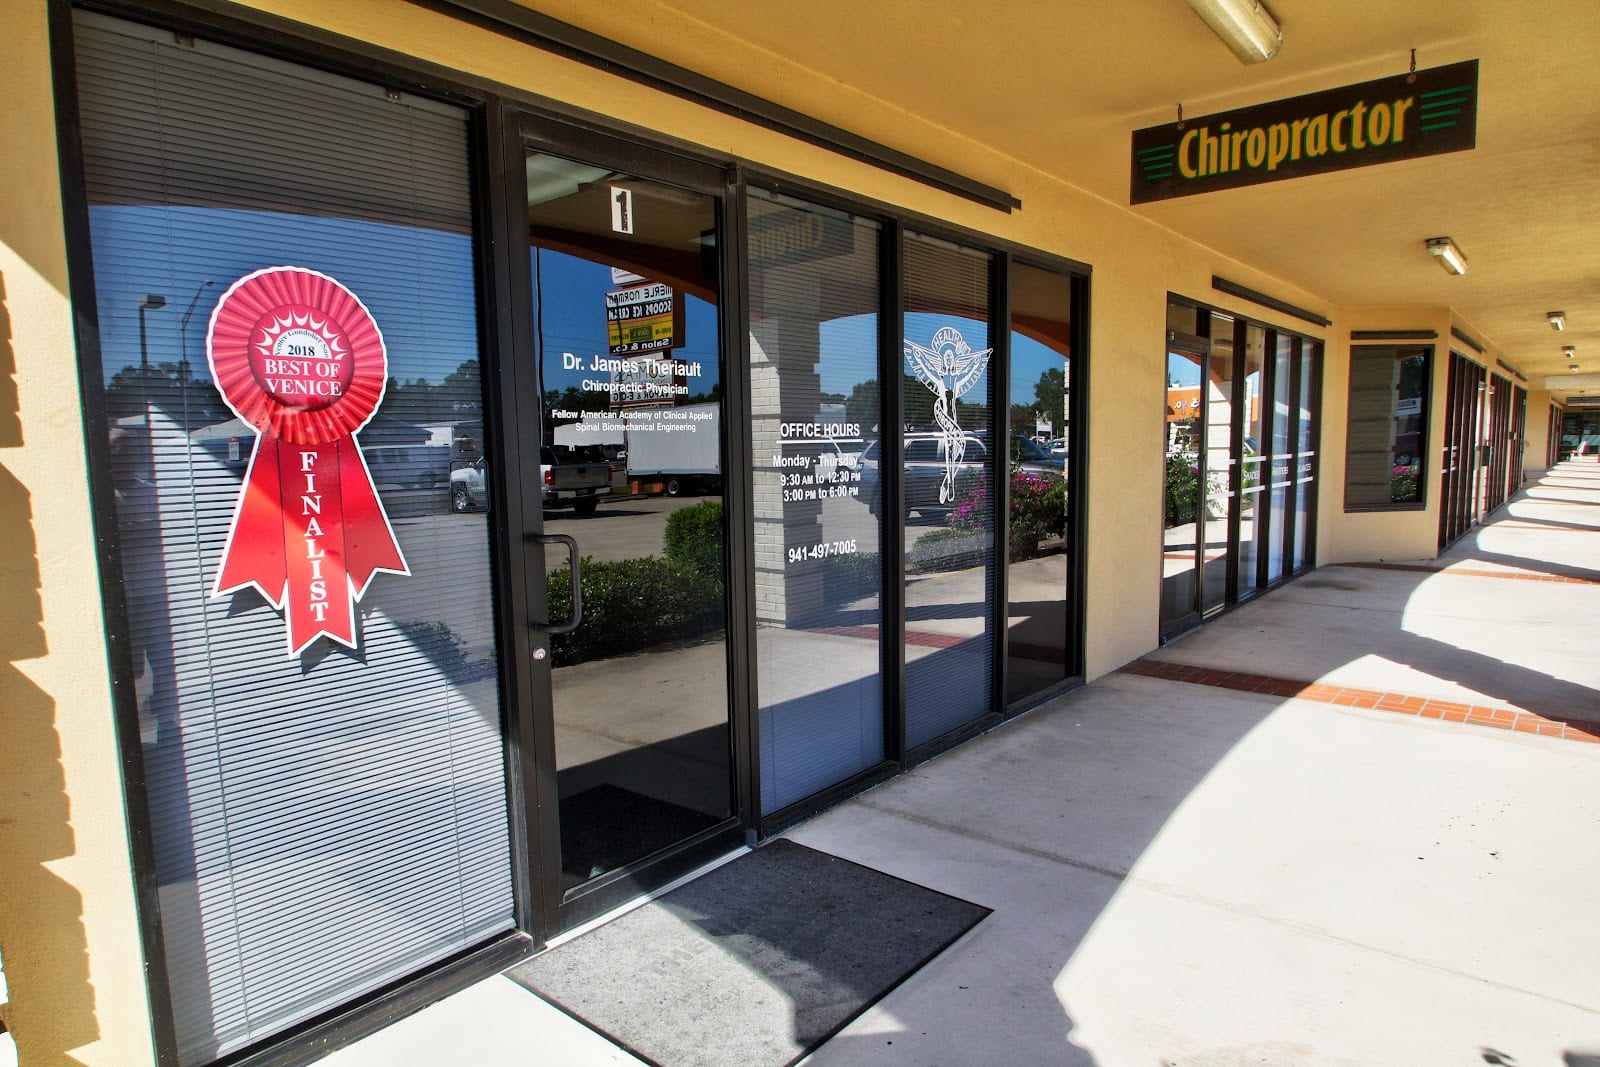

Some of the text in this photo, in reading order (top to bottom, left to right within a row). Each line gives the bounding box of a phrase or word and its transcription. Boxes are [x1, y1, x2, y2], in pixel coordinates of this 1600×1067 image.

[1178, 96, 1415, 180] Chiropractor
[615, 190, 629, 232] 1
[933, 329, 960, 348] HEALTH
[287, 344, 315, 357] 2018
[264, 358, 341, 378] BEST OF
[562, 352, 702, 377] Dr. James Theriault
[264, 378, 343, 396] VENICE
[581, 379, 643, 395] Chiropractic
[645, 382, 689, 397] Physician
[551, 409, 713, 422] Fellow American Academy of Clinical Applied
[575, 422, 696, 434] Spinal Biomechanical Engineering
[780, 423, 860, 437] OFFICE HOURS
[772, 454, 811, 469] Monday
[817, 455, 859, 469] Thursday
[780, 470, 861, 487] 9:30 AM to 12:30 PM
[783, 485, 859, 502] 3:00 PM to 6:00 PM
[299, 451, 329, 622] FINALIST
[788, 539, 857, 563] 941-497-7005
